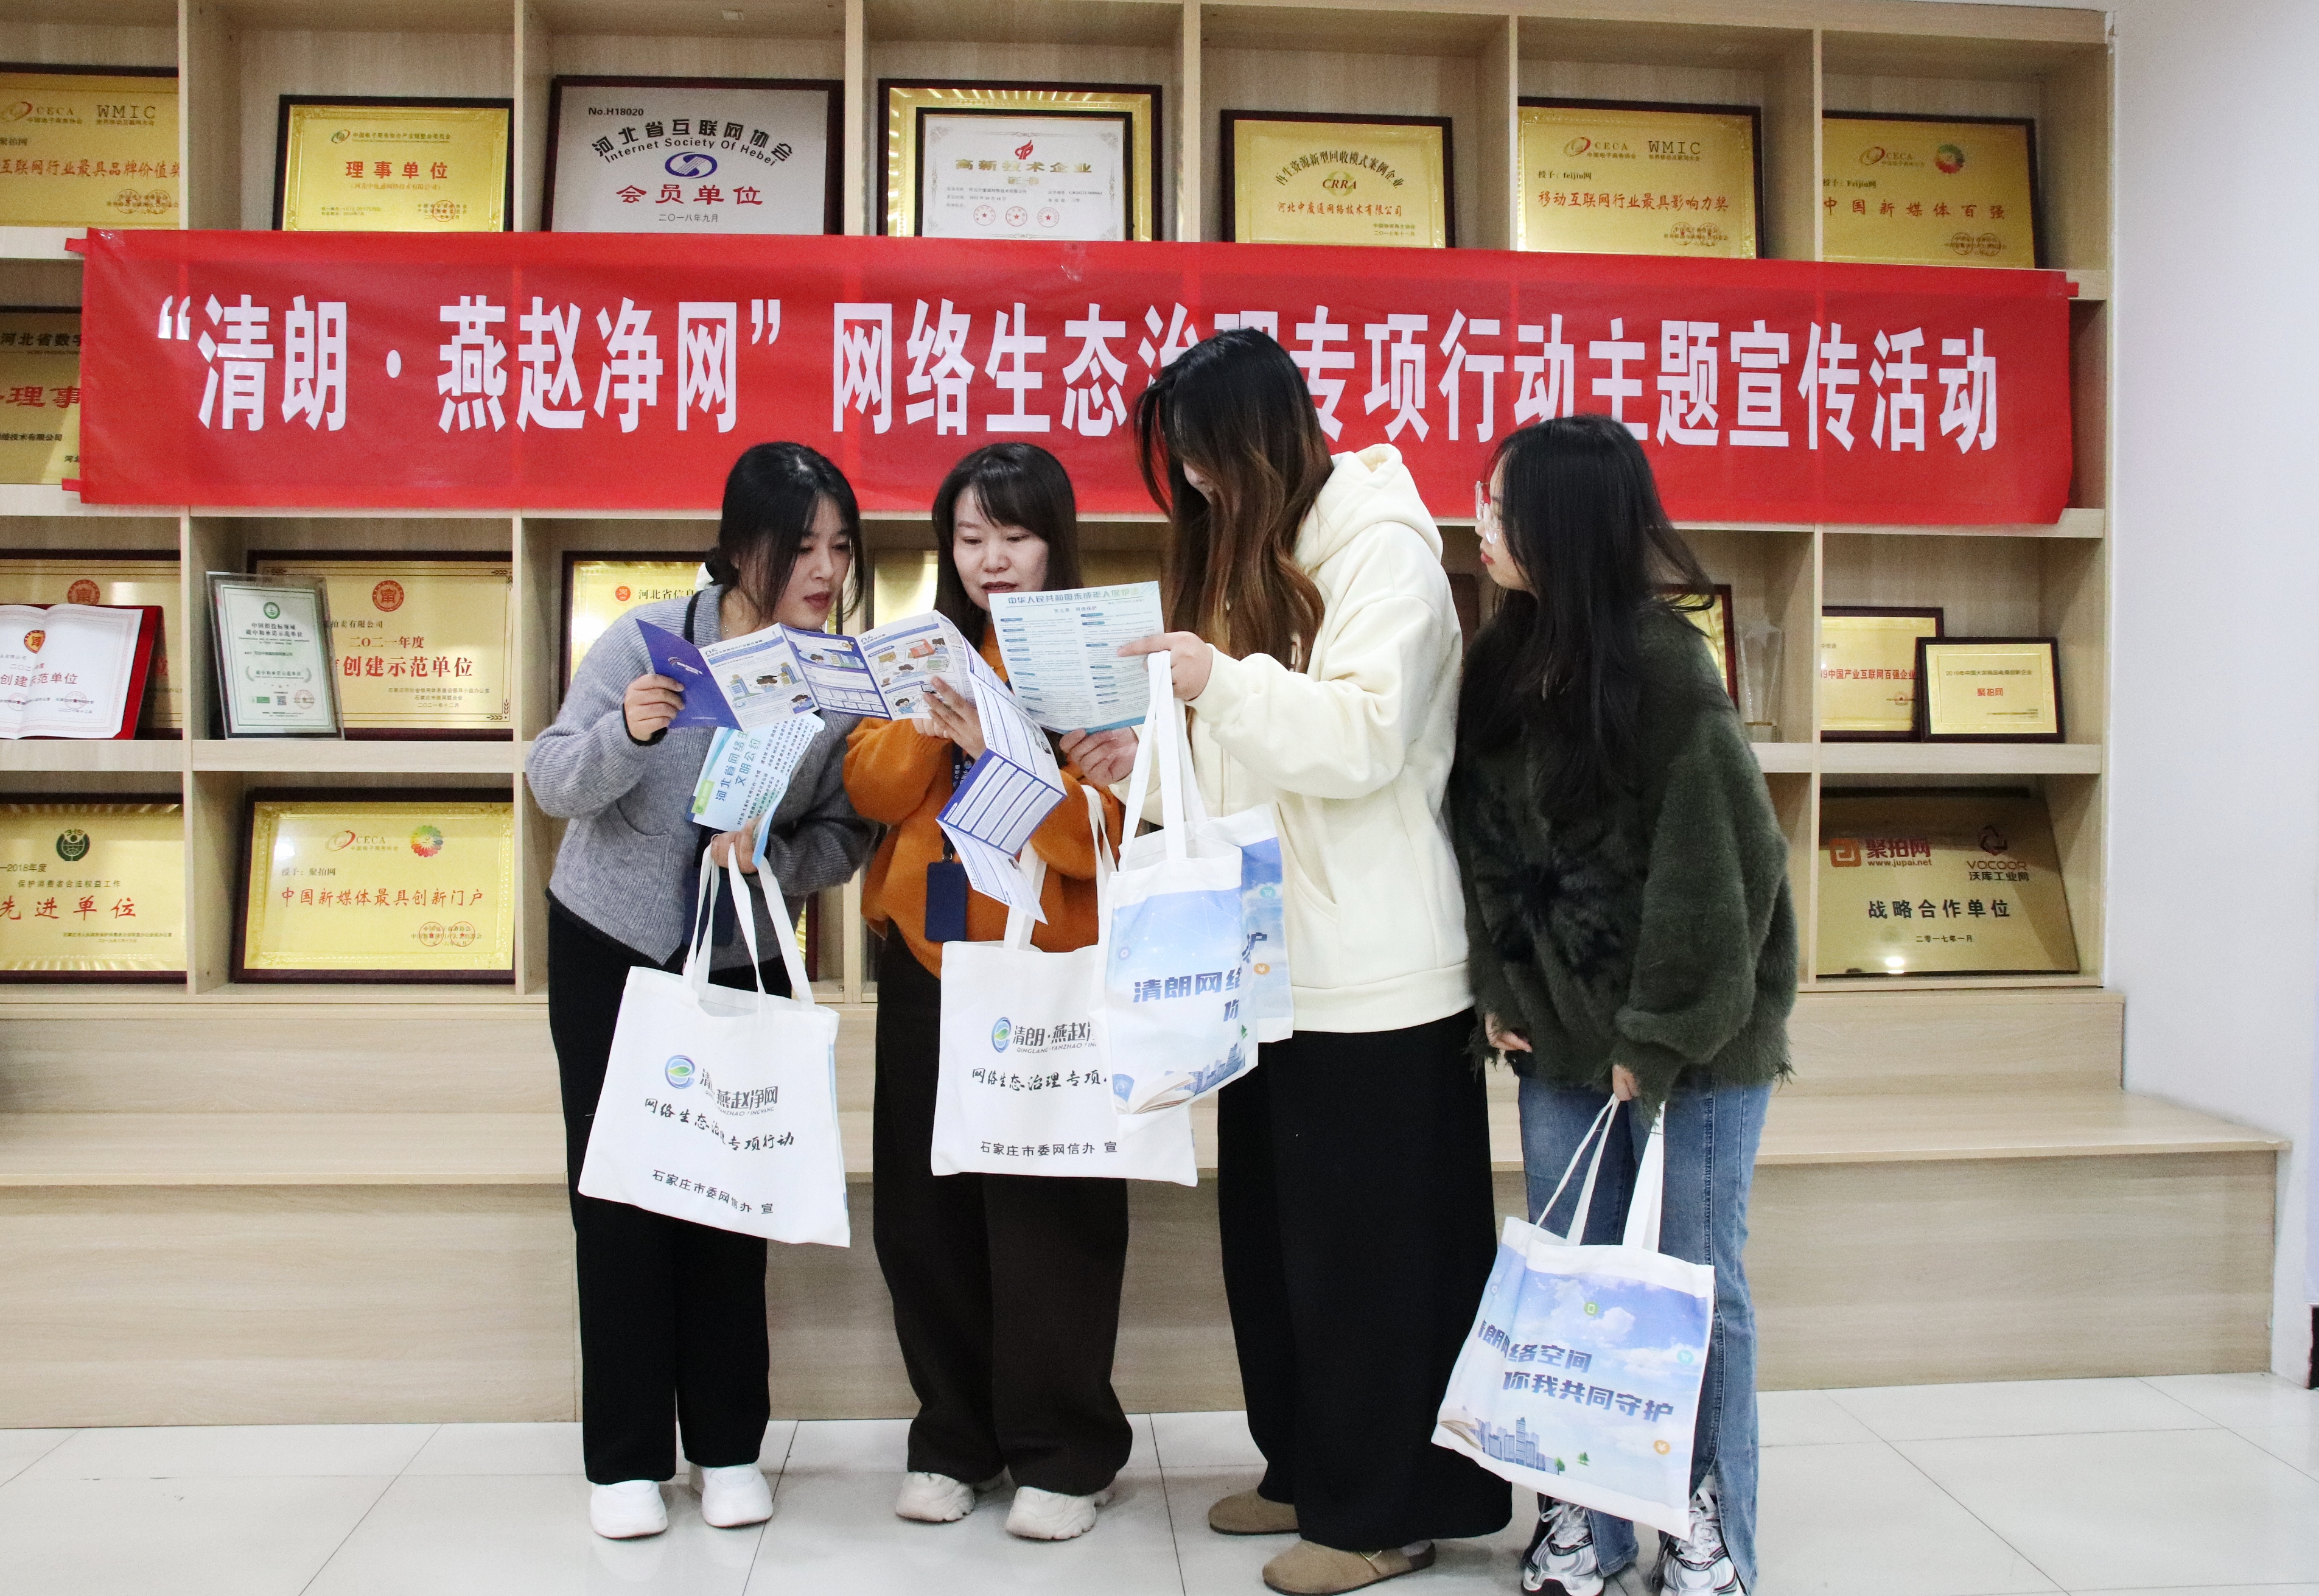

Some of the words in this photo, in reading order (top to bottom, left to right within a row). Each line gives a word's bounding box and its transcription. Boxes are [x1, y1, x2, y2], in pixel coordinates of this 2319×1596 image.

[37, 107, 74, 116] CECA
[97, 105, 156, 119] WMIC
[588, 107, 644, 116] No.H18020
[592, 119, 792, 162] 河北省互联网协会
[1595, 142, 1628, 151] CECA
[1648, 141, 1701, 155] WMIC
[605, 140, 659, 164] Internet
[665, 138, 715, 149] Society
[721, 140, 737, 151] Of
[740, 144, 777, 167] Hebei
[346, 161, 447, 179] 理事单位
[954, 158, 1092, 173] 高新技术企业
[1276, 150, 1403, 189] 再生资源新型回收模式案例企业
[1323, 178, 1357, 190] CRRA
[616, 184, 763, 205] 会员单位
[1539, 191, 1730, 212] 移动互联网行业最具影响力奖
[1824, 197, 2006, 220] 中国新媒体百强
[833, 298, 1998, 454] 网络生态治专项行动主题宣传活动
[1977, 688, 2004, 696] 聚拍网
[734, 737, 761, 788] 文明公约
[356, 836, 386, 844] CECA
[1866, 838, 1931, 858] 聚拍网
[1867, 858, 1932, 868] www.jupai.net
[18, 880, 121, 888] 保护消费者合法权益工作
[1968, 871, 2029, 881] 沃库工业网
[281, 887, 484, 908] 中国新媒体最具创新门户
[0, 895, 136, 920] 先进单位
[1869, 899, 2011, 919] 战略合作单位
[1916, 934, 1973, 943] 二零一七年一月
[973, 1067, 1107, 1092] 网络生态治理专项
[981, 1141, 1096, 1157] 石家庄市委网信办
[1104, 1141, 1118, 1154] 宣
[652, 1169, 753, 1214] 石家庄市委网信办
[761, 1203, 774, 1214] 宣
[1502, 1371, 1674, 1423] 你我共同守护
